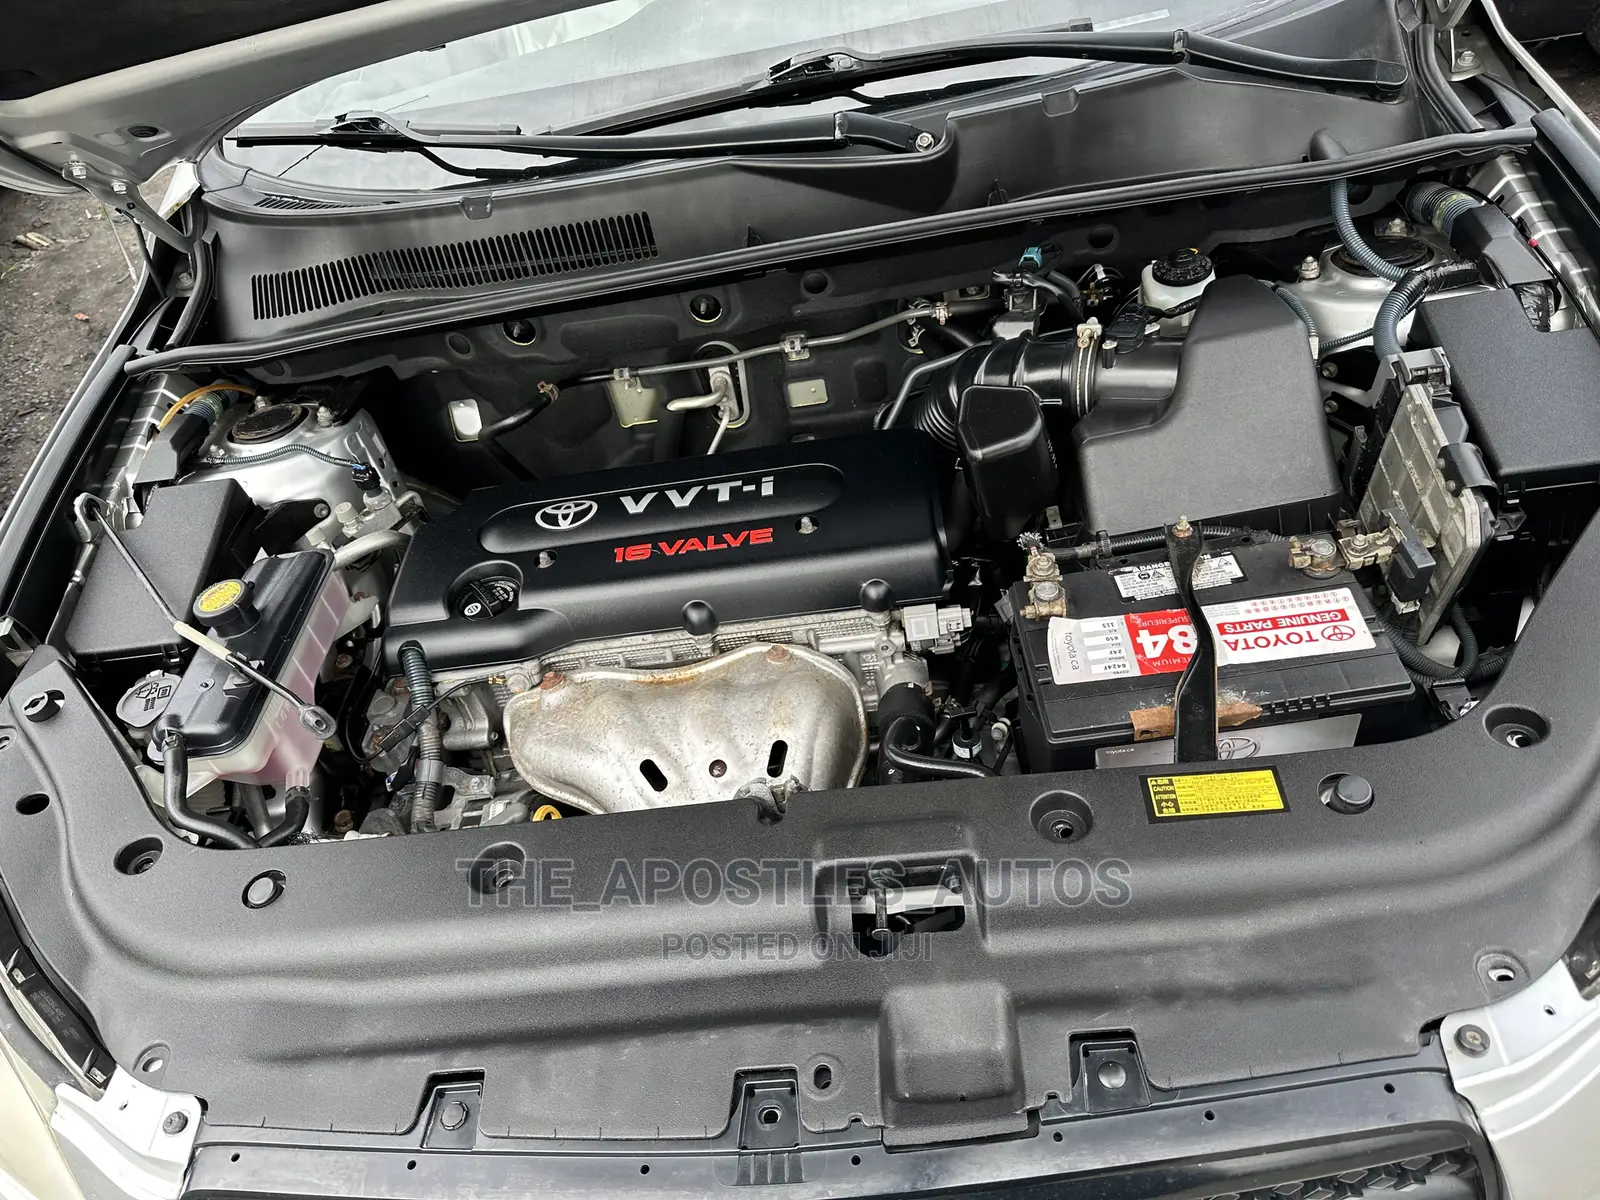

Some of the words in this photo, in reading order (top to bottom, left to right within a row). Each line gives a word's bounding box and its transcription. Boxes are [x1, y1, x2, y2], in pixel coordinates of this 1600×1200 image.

[619, 476, 775, 514] VVT-i
[613, 543, 653, 563] 16
[658, 527, 774, 556] VALVE
[1139, 561, 1171, 571] DANGE
[1223, 618, 1273, 633] PARTS
[1278, 611, 1342, 627] GENUINE
[1063, 632, 1080, 671] toyota.ca
[1136, 625, 1198, 659] 84
[1222, 630, 1320, 652] TOYOTA
